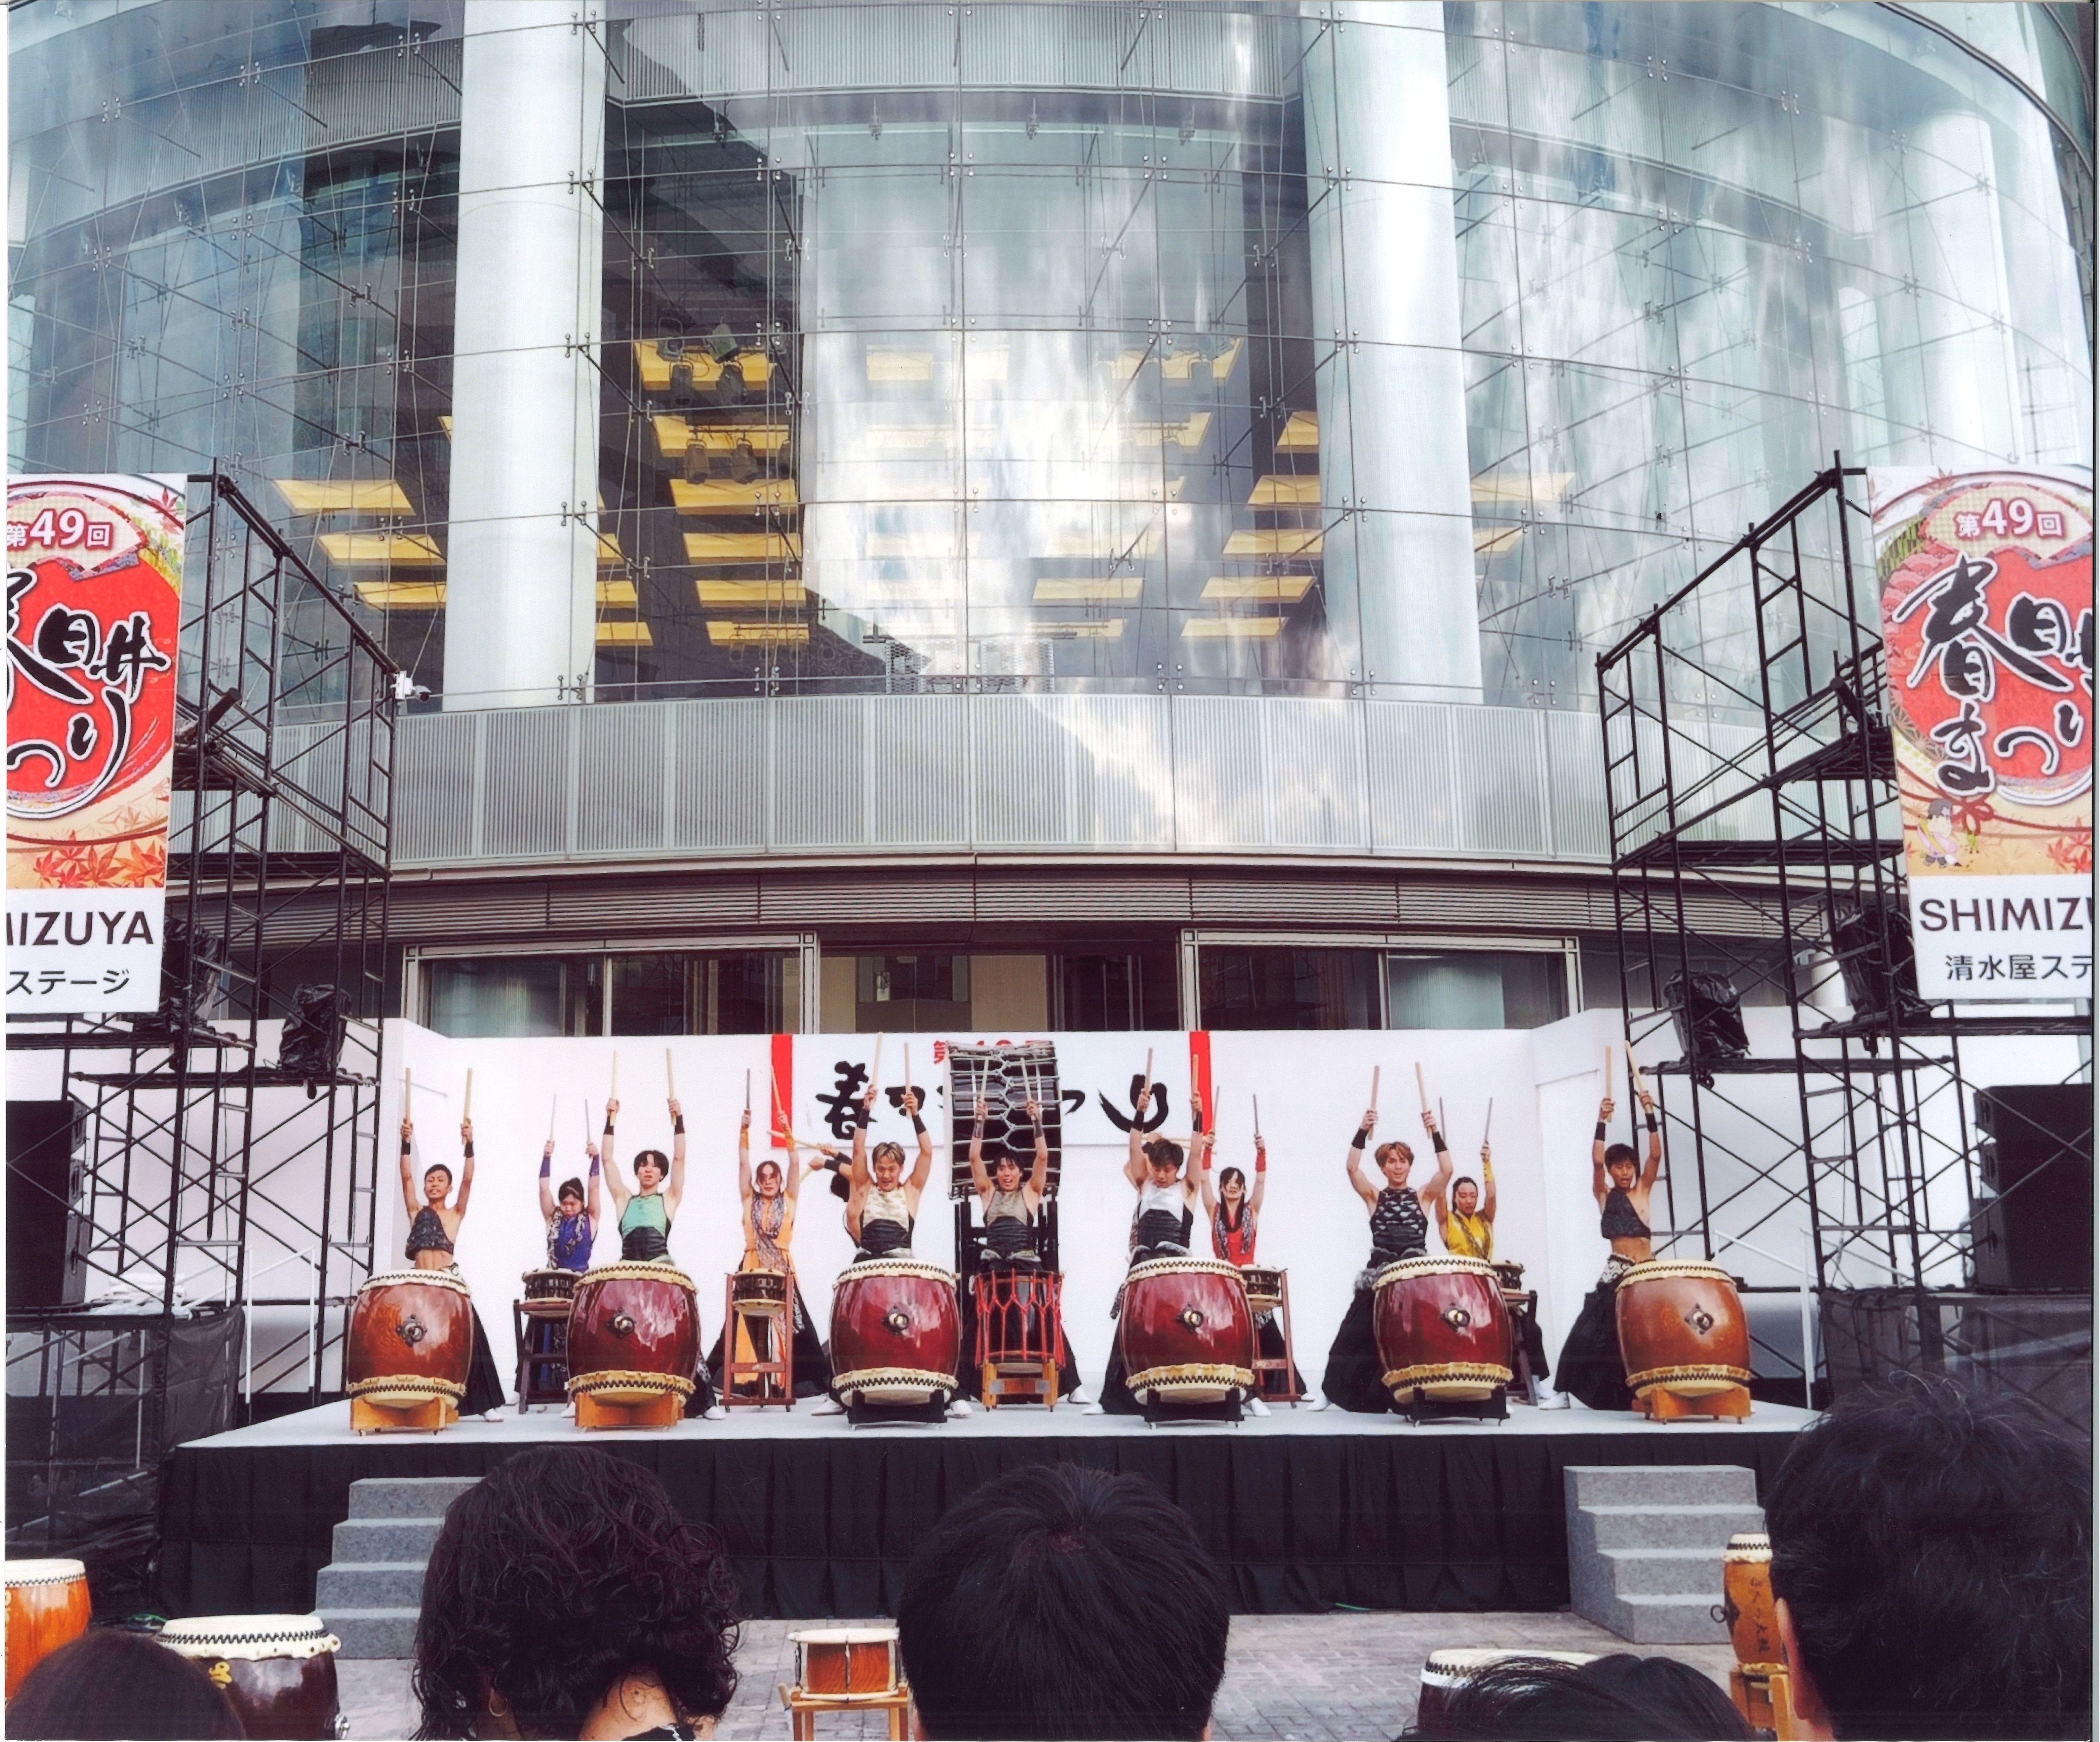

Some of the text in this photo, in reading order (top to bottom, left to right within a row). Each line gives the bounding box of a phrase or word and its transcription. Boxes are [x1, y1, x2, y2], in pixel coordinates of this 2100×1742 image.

[6, 509, 111, 548] 第49回
[1955, 499, 2064, 538] 第49回
[1920, 897, 2092, 931] SHIMIZ
[6, 968, 130, 995] ステージ
[1946, 954, 2092, 980] 清水屋ステ
